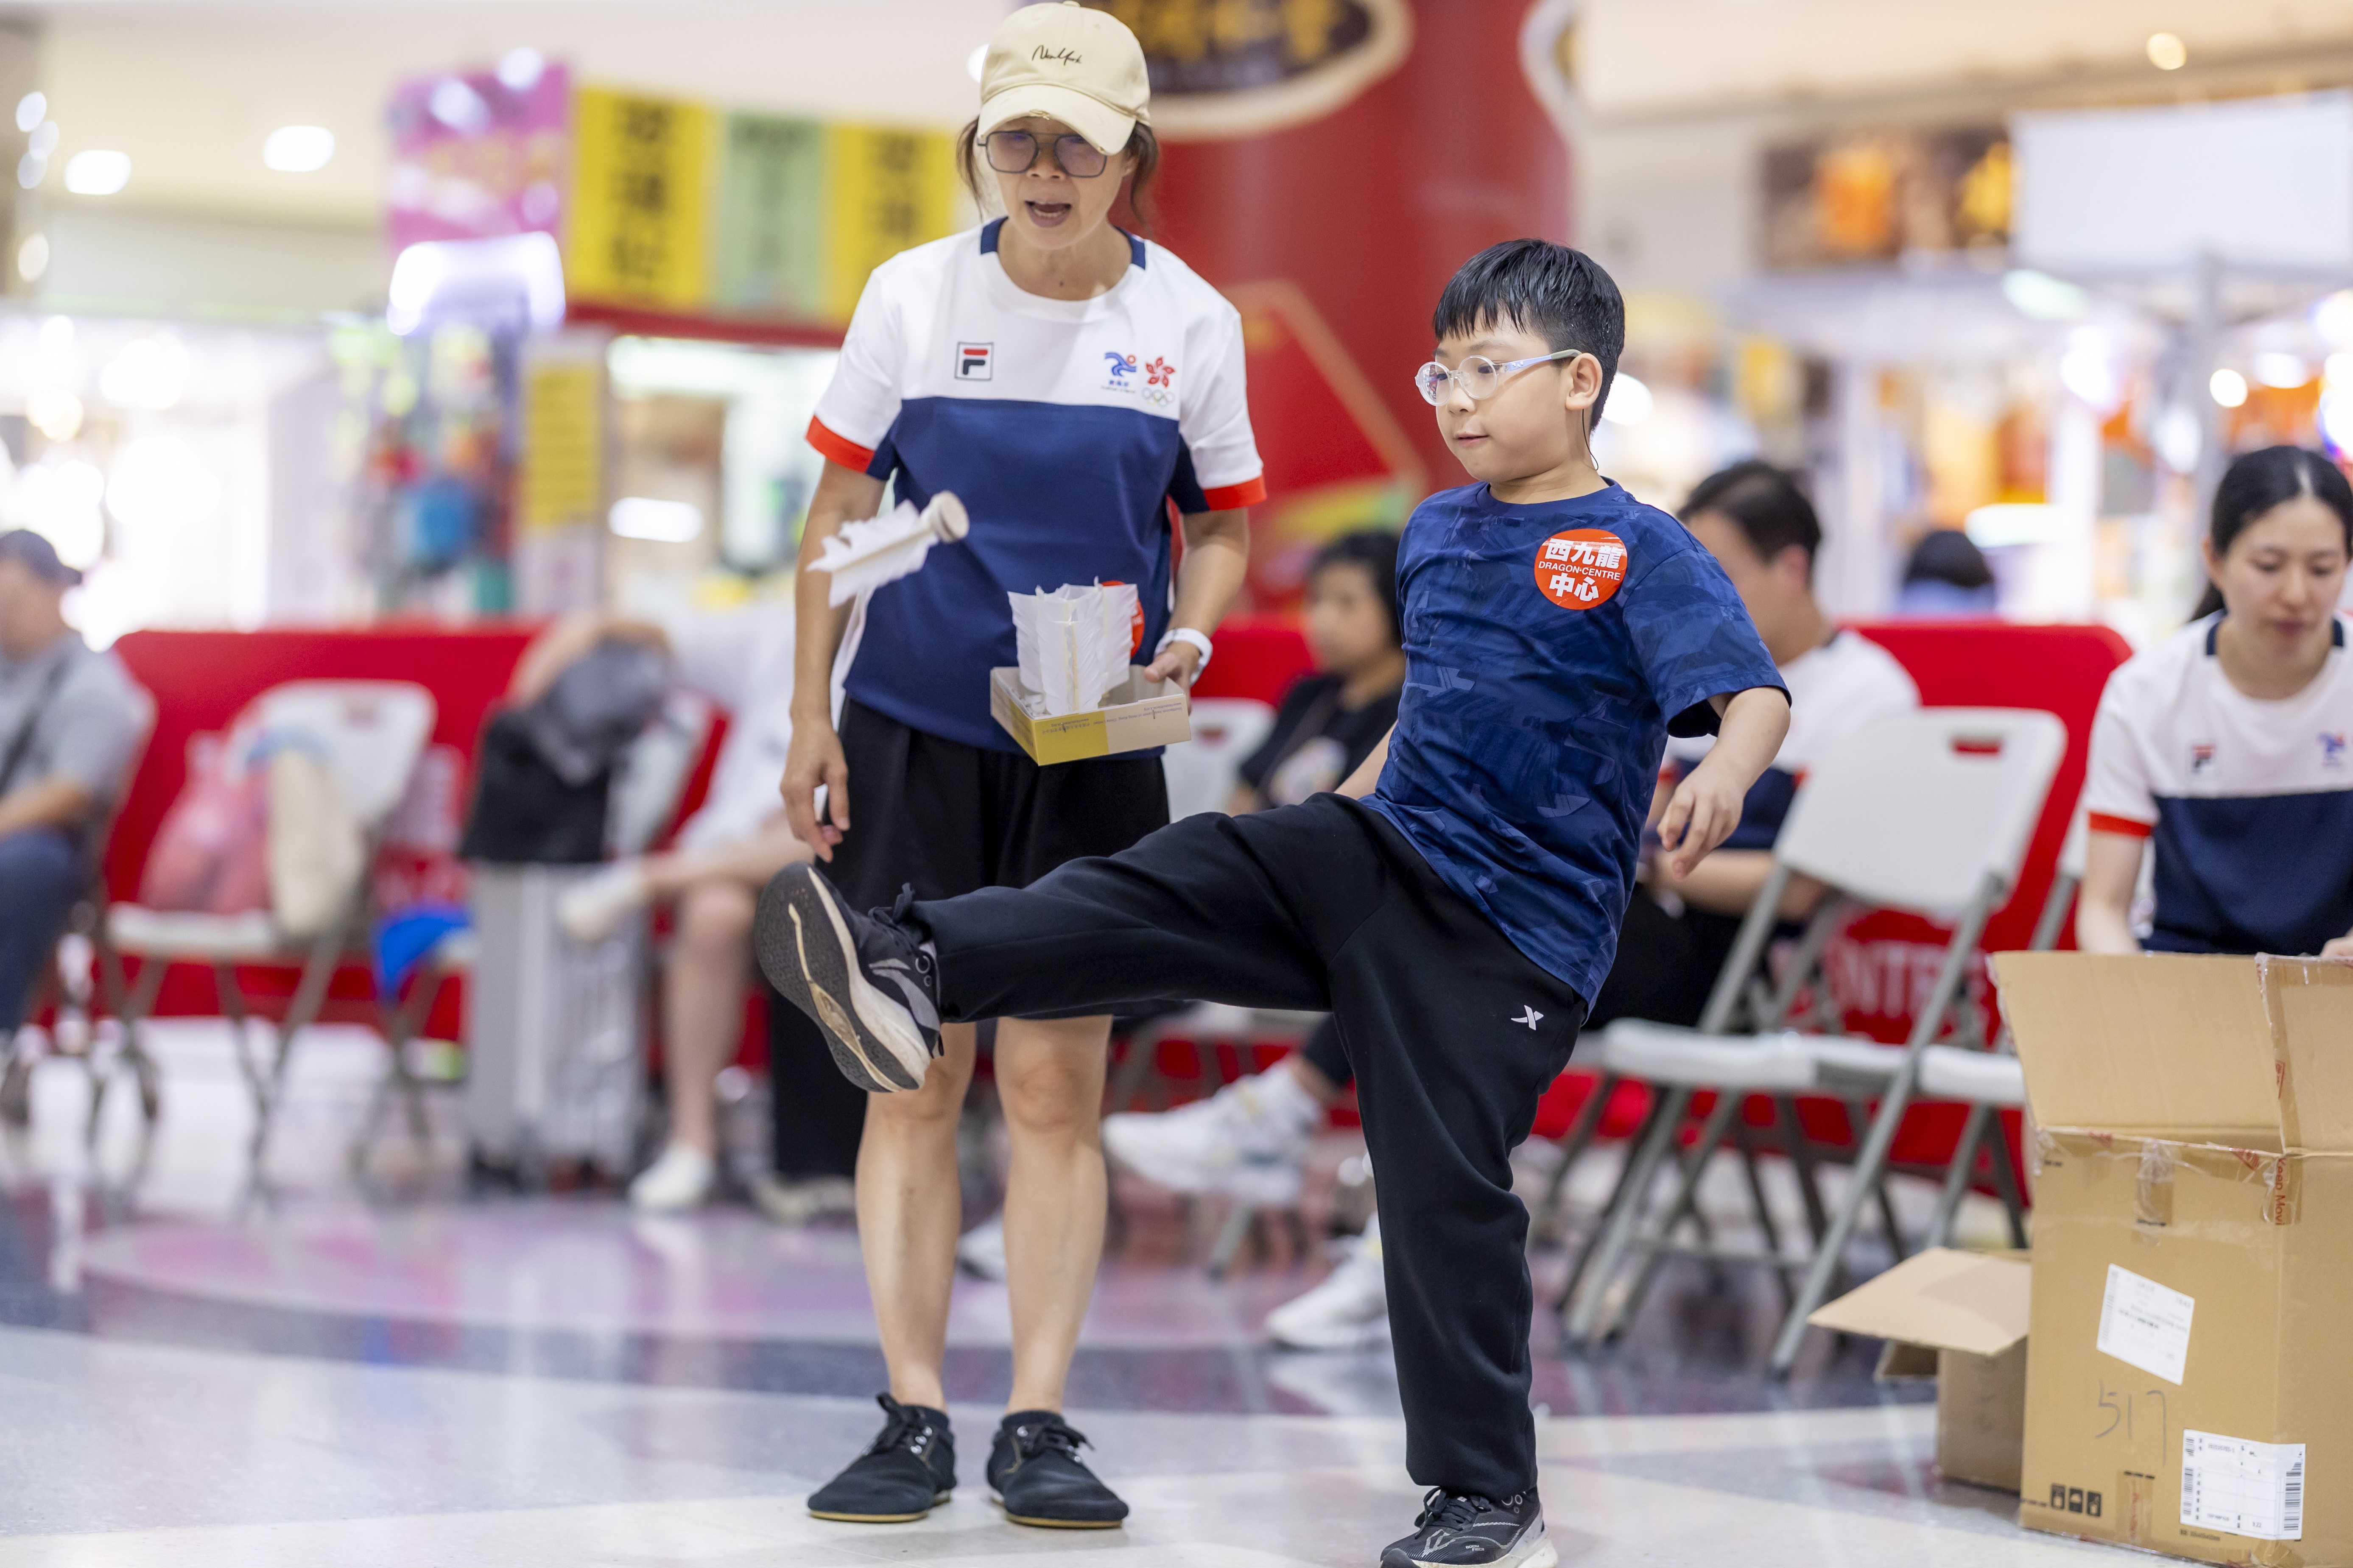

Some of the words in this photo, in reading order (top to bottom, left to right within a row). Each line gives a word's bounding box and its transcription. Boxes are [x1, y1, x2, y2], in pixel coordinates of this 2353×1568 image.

[1545, 538, 1624, 569] 西九龍
[1549, 572, 1599, 601] 中心
